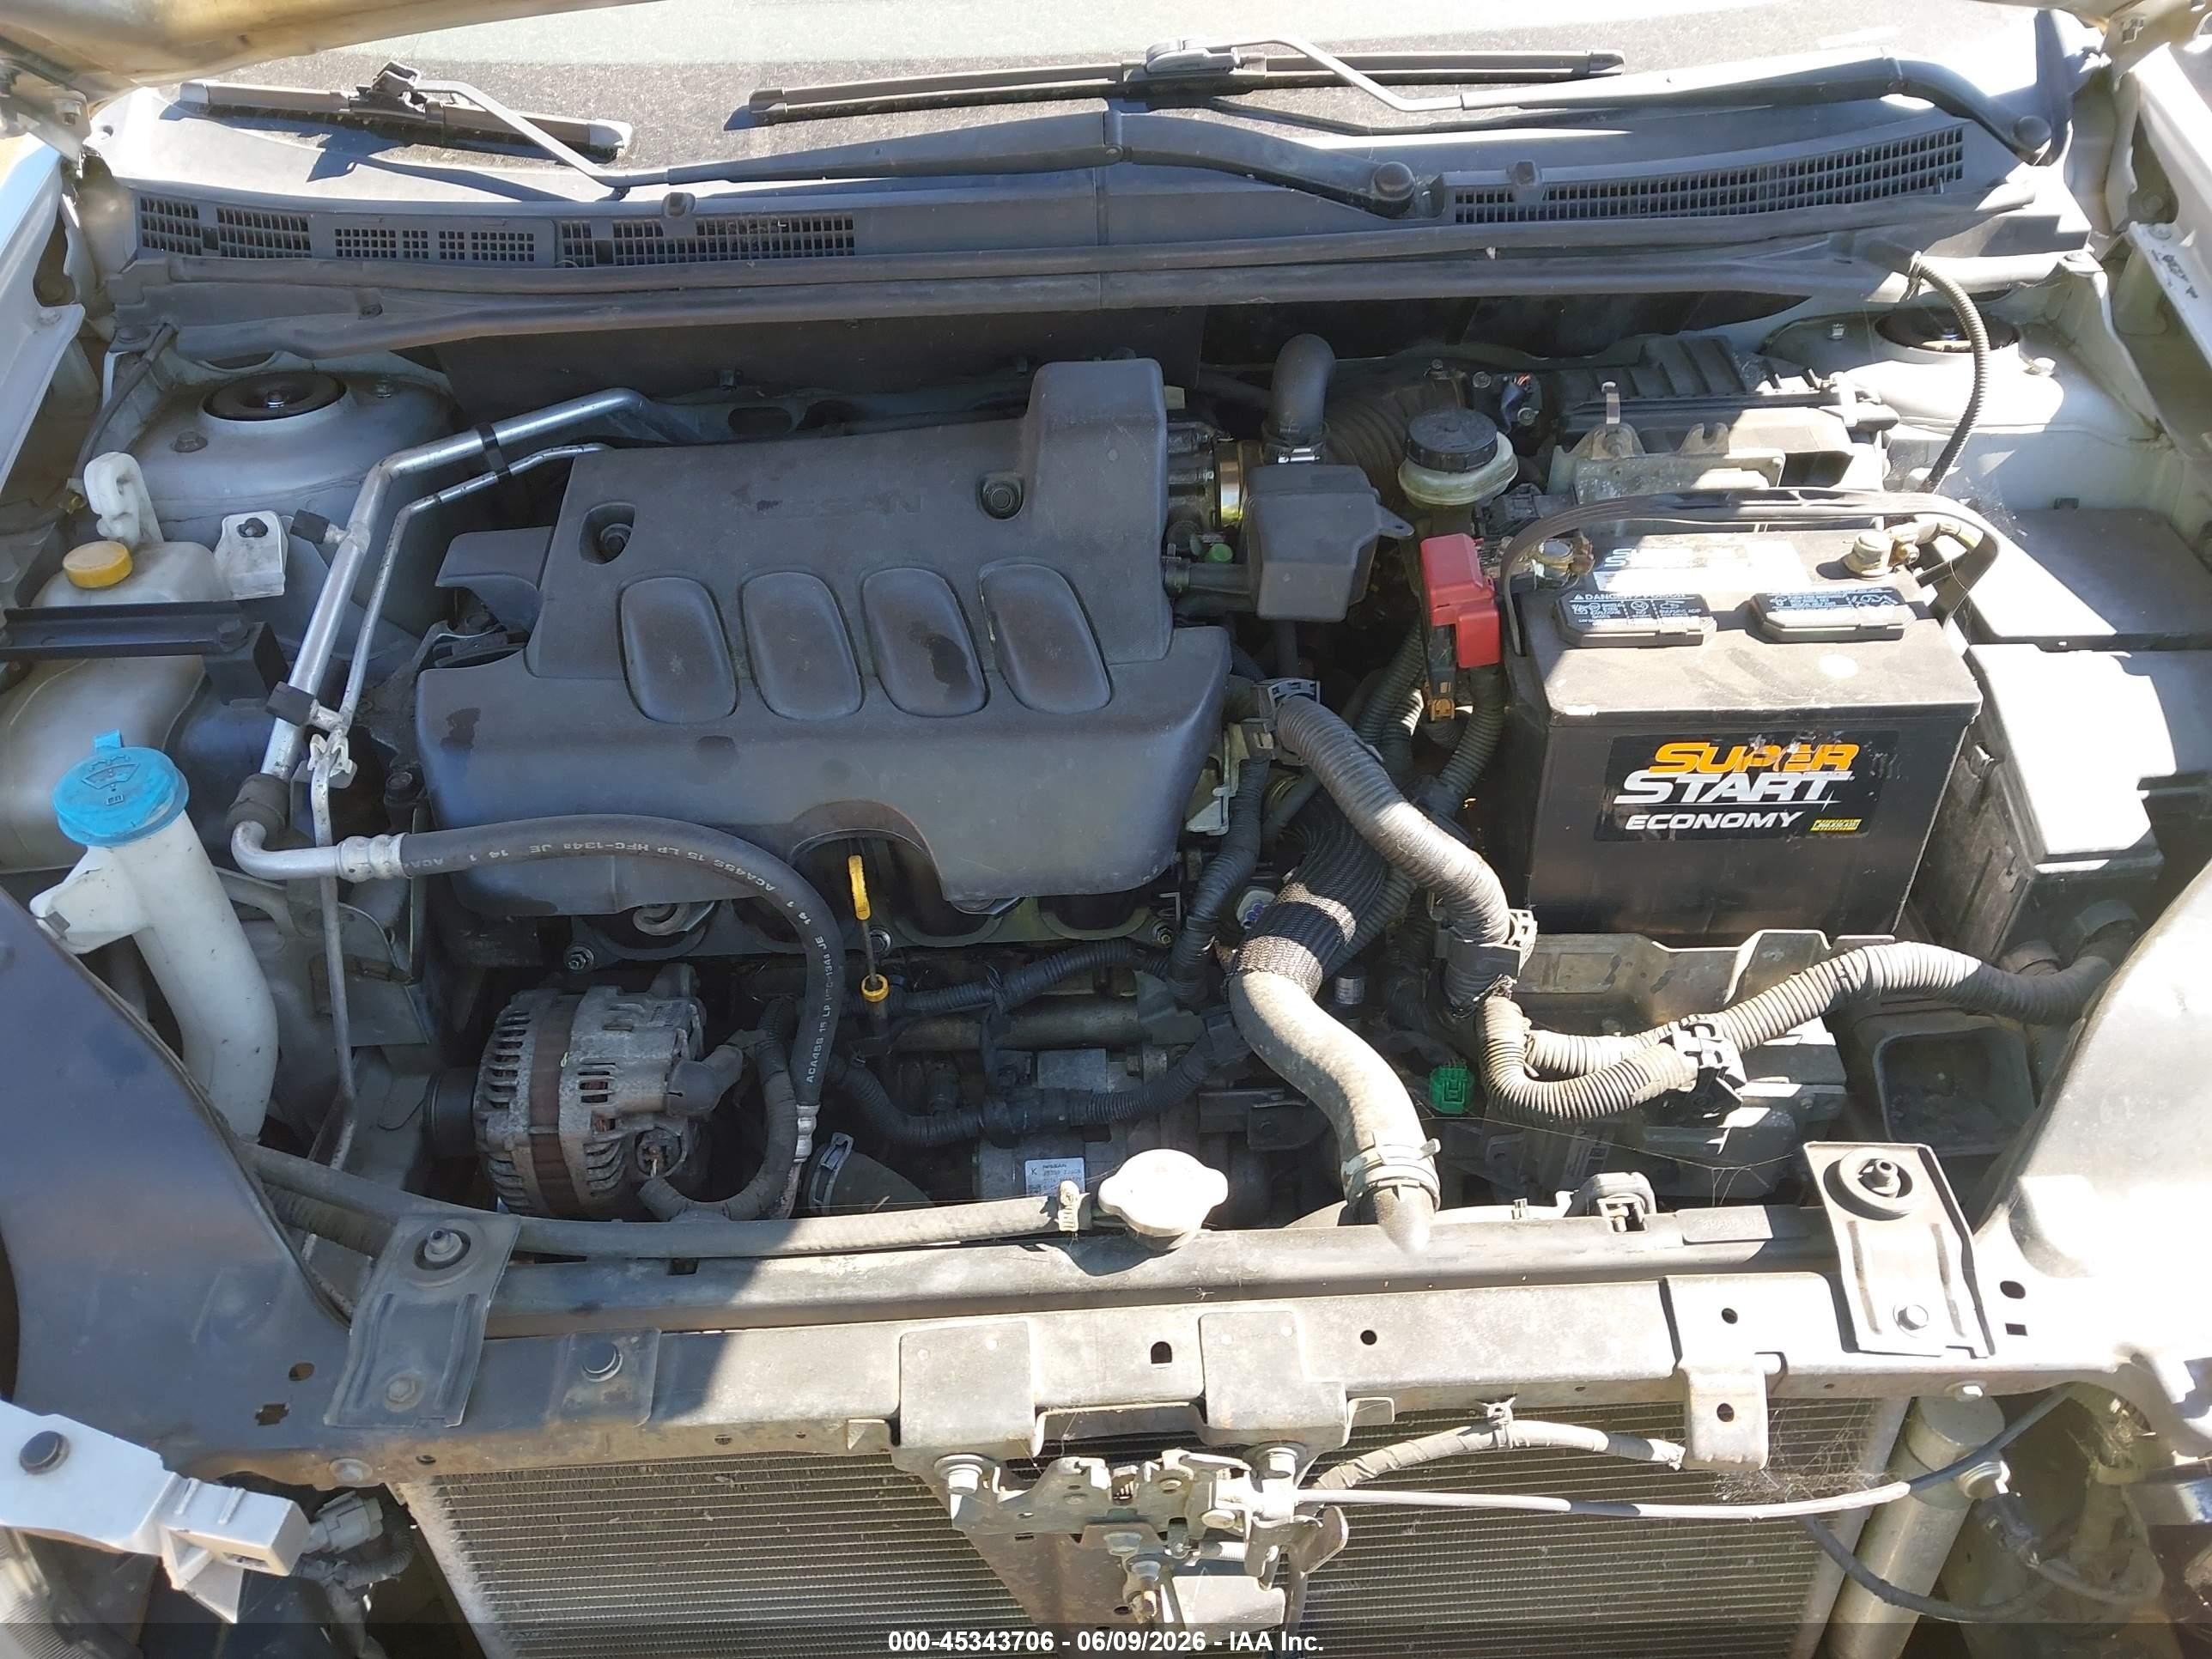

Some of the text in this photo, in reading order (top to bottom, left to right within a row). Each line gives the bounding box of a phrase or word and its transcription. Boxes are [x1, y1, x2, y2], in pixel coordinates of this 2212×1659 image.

[1649, 742, 1860, 774] SUPER
[1613, 770, 1853, 805] START
[1626, 811, 1804, 830] ECONOMY
[529, 844, 552, 853] JE
[657, 846, 679, 855] LP
[687, 852, 706, 861] 15
[814, 935, 827, 950] JE
[823, 1005, 831, 1018] LP
[1031, 1167, 1037, 1176] K
